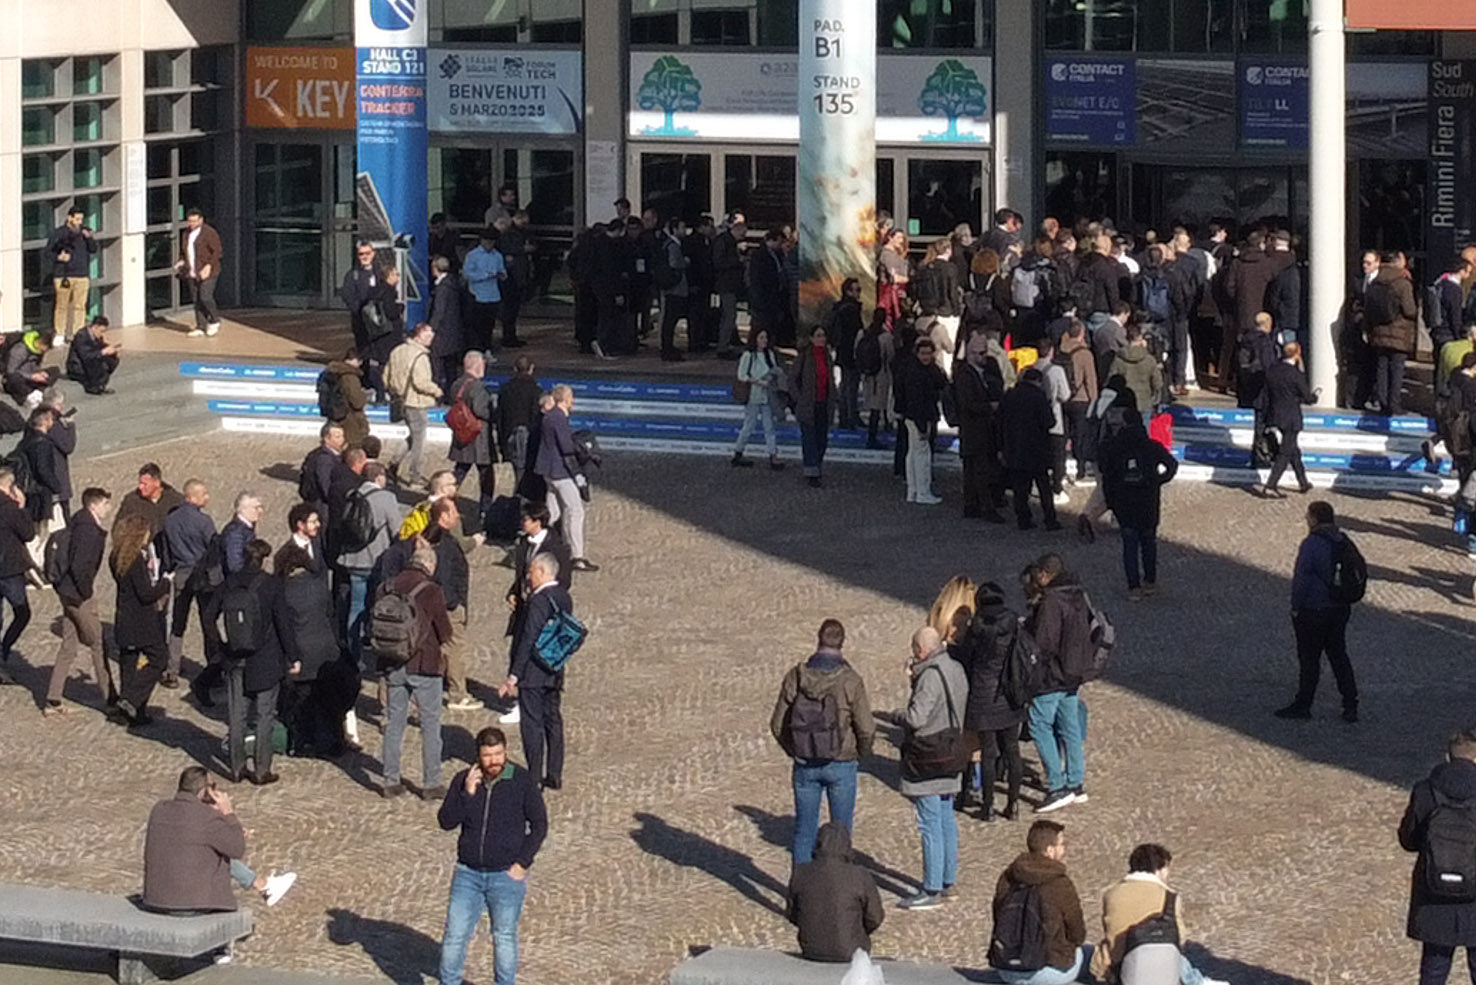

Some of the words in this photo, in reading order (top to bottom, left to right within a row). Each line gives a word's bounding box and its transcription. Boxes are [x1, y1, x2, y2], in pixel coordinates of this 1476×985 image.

[814, 19, 845, 33] PAD.
[370, 49, 399, 61] HALL
[815, 37, 841, 58] B1
[254, 55, 319, 69] WELCOME
[323, 56, 338, 69] TO
[362, 61, 402, 74] STAND
[404, 62, 425, 75] 121
[1068, 63, 1125, 76] CONTACT
[1432, 61, 1462, 79] Sud
[527, 69, 557, 80] TECH
[813, 75, 861, 89] STAND
[449, 84, 546, 100] BENVENUTI
[1432, 80, 1475, 98] South
[296, 79, 350, 119] KEY
[814, 93, 854, 115] 135
[1432, 105, 1455, 157] Fiera
[1432, 159, 1455, 228] Rimini
